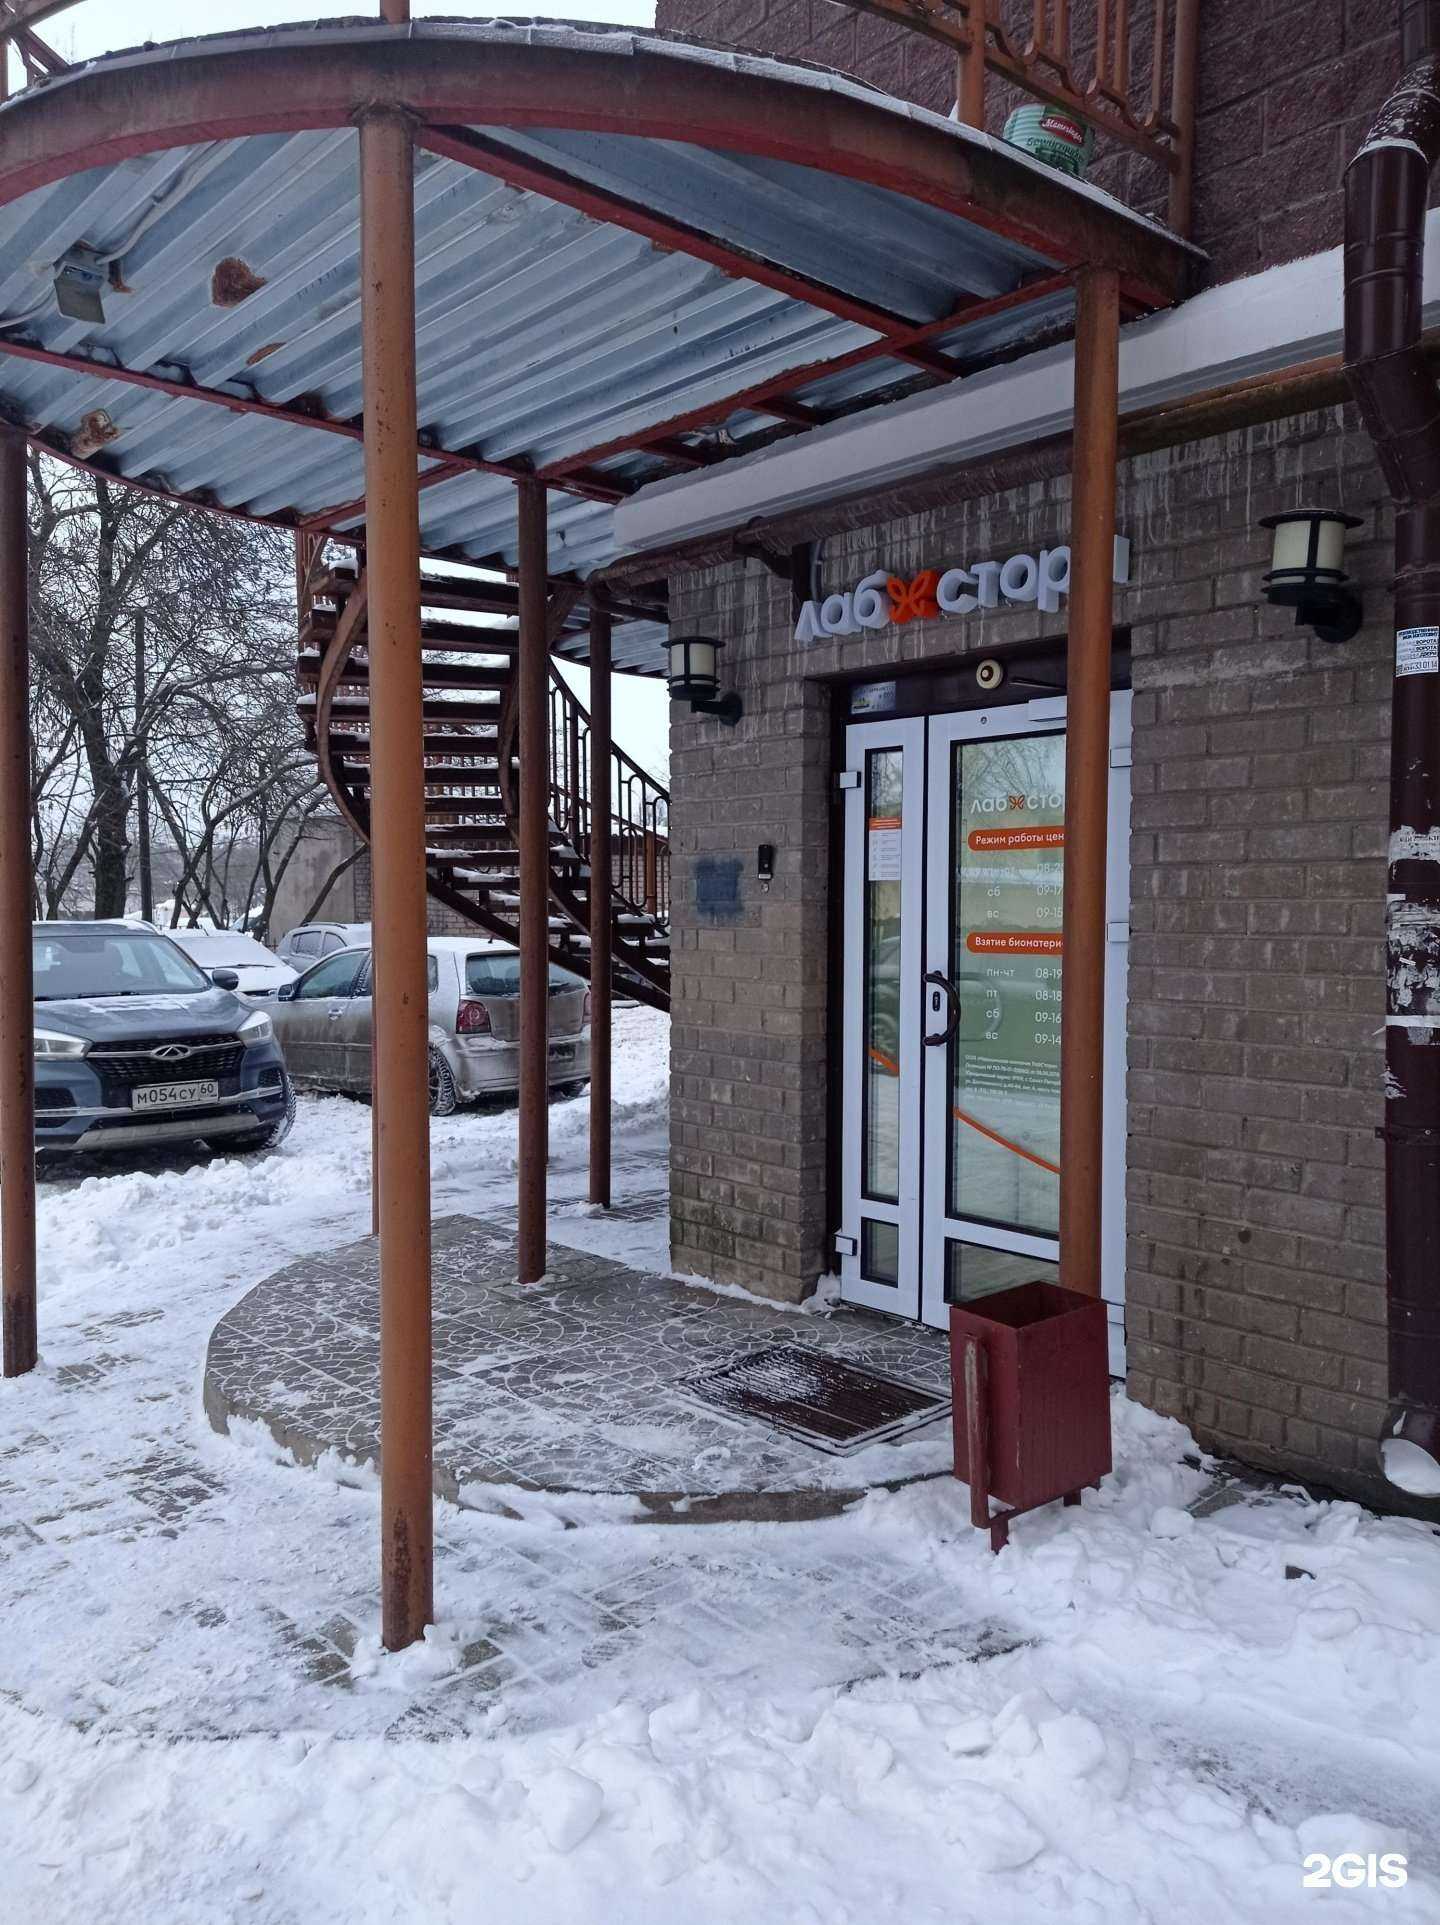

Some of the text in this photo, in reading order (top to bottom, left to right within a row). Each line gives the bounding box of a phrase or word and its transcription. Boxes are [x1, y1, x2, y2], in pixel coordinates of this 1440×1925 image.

[975, 835, 1006, 845] Режим
[1008, 833, 1043, 845] работы
[987, 885, 1001, 897] сб
[986, 910, 1000, 918] вс
[975, 936, 1063, 950] Взятие биоматери
[986, 967, 1062, 979] пн-чт 08-19
[986, 989, 1062, 1001] пт 08-18
[985, 1008, 1062, 1024] сб 09-16
[985, 1032, 1061, 1045] вс 09-14
[200, 1083, 214, 1094] 60
